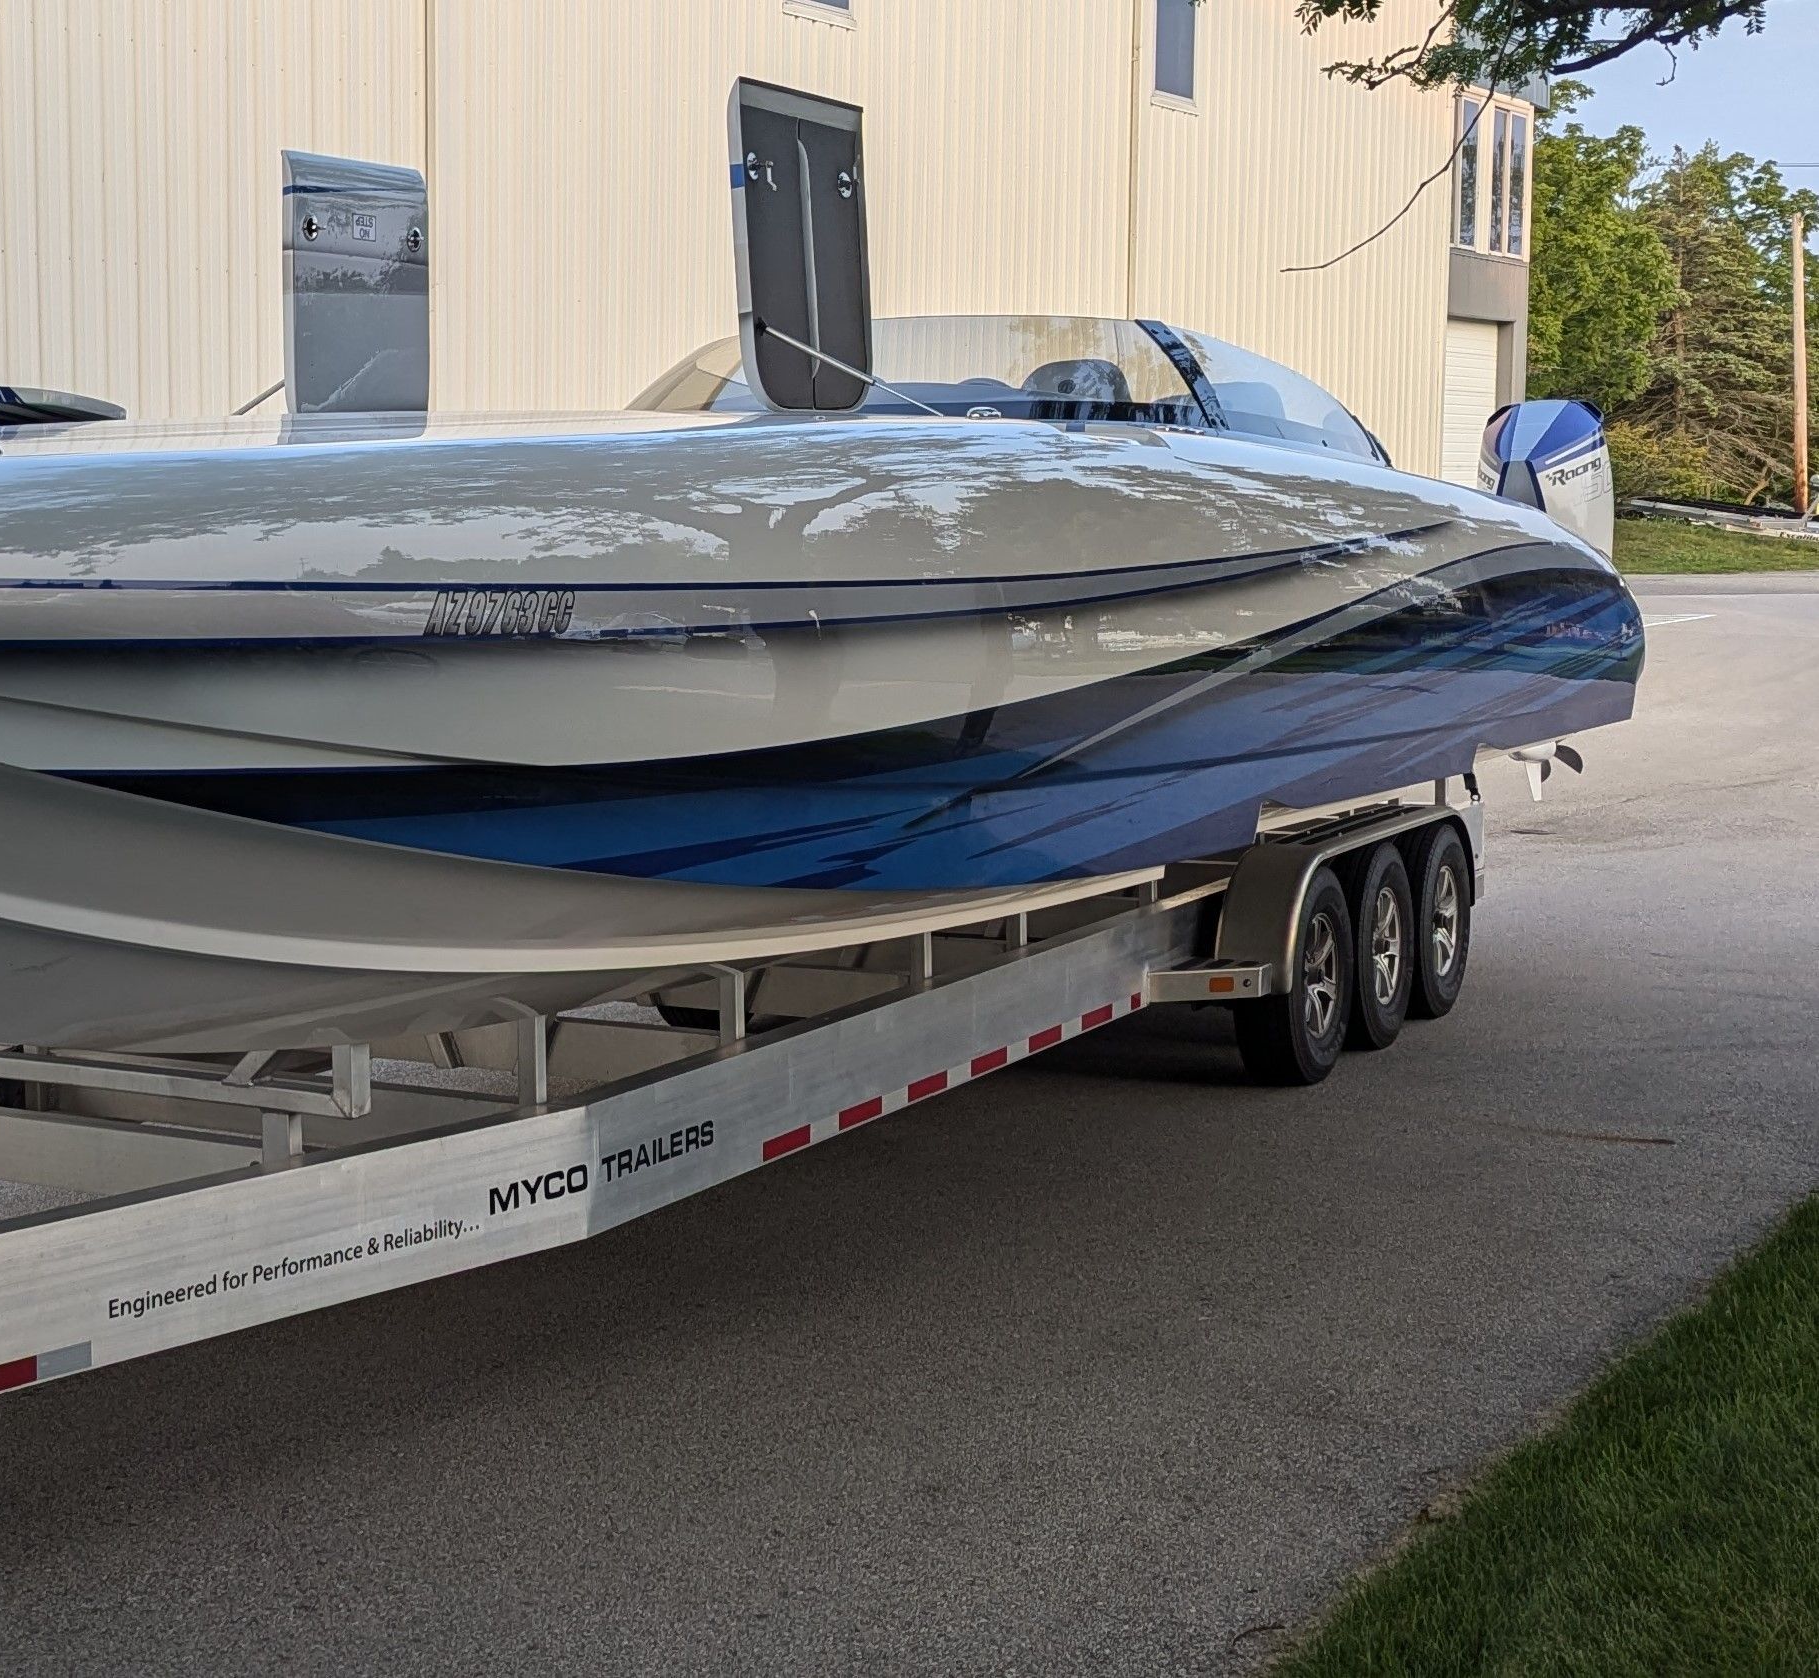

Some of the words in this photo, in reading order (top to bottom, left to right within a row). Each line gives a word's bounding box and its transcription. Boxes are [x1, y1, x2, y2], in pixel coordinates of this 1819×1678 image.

[355, 216, 374, 228] STEP
[359, 228, 370, 240] NO
[1546, 457, 1602, 487] Racing
[489, 1164, 588, 1215] MYCO
[601, 1120, 714, 1182] TRAILERS
[109, 1273, 217, 1319] Engineered
[222, 1270, 248, 1291] for
[252, 1244, 363, 1285] Performance
[367, 1237, 380, 1256] &
